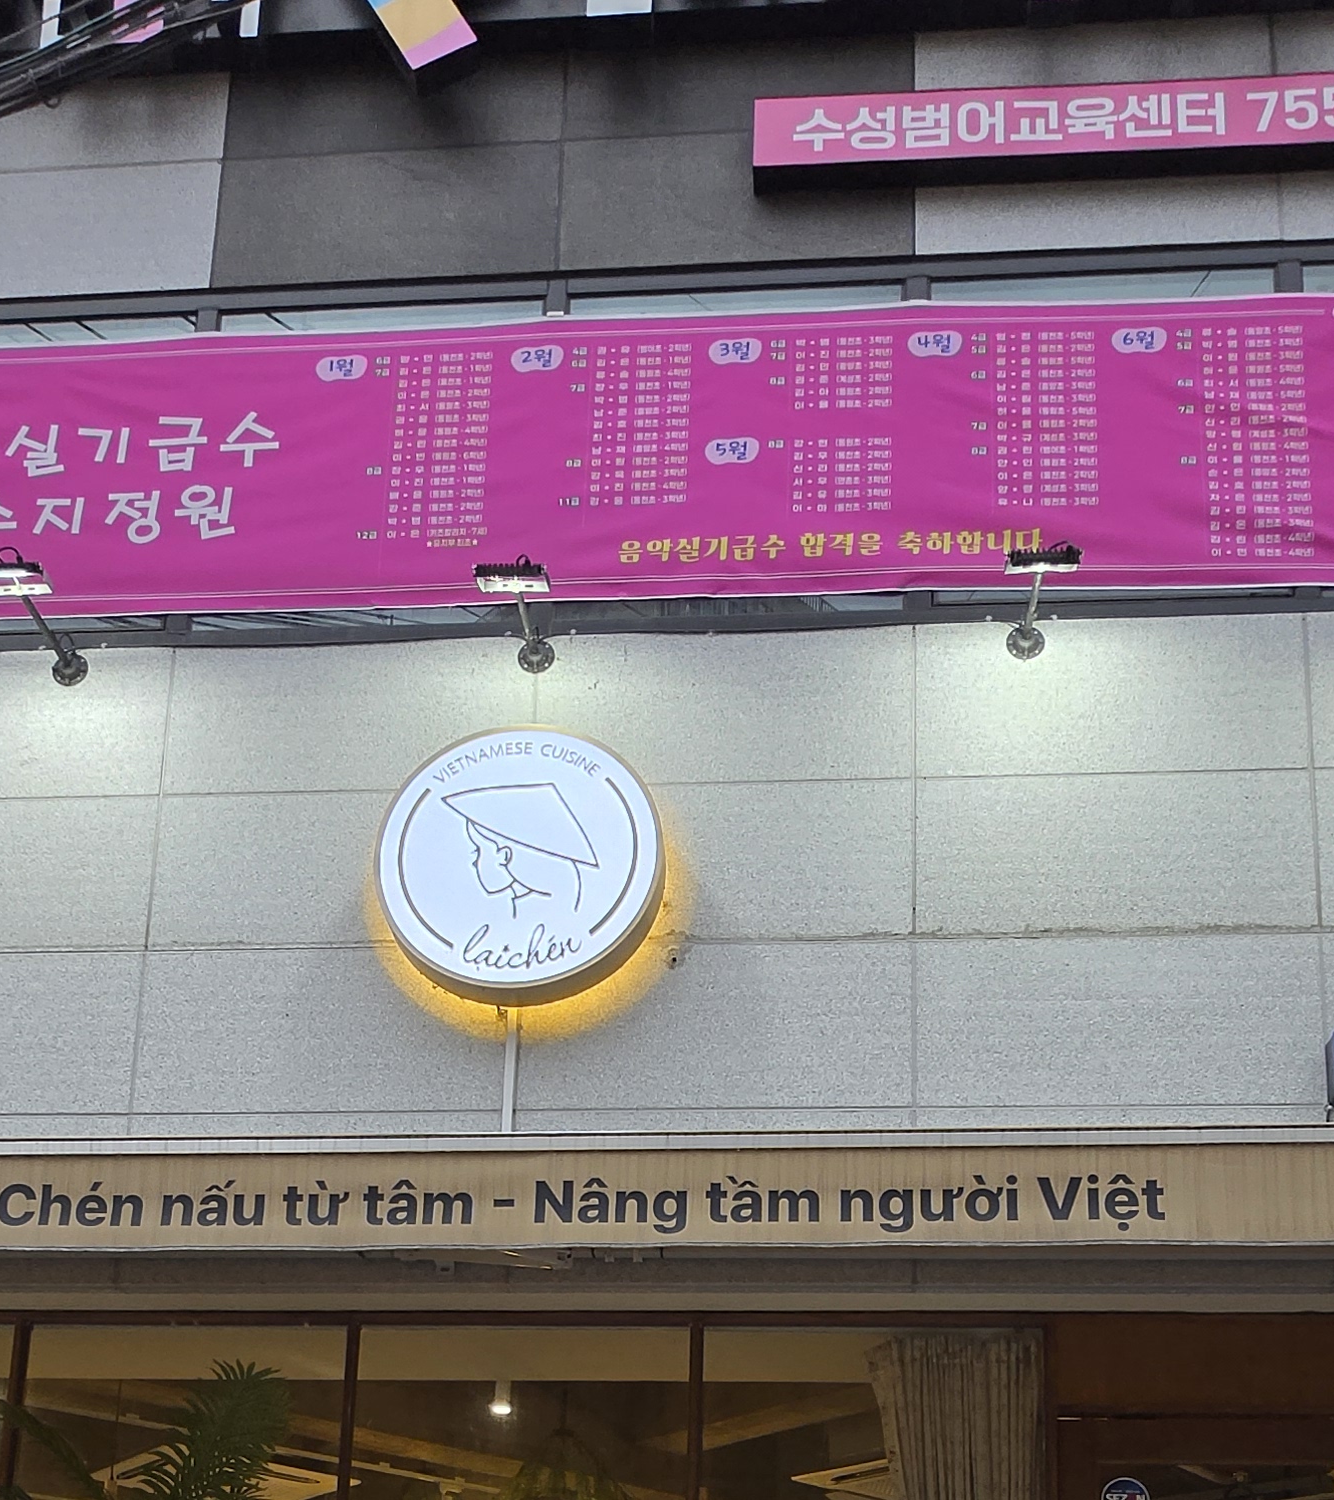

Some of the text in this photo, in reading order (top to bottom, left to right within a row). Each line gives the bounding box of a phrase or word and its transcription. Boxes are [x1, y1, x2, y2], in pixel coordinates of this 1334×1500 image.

[792, 92, 1226, 151] 수성범어교육센터
[1123, 331, 1154, 349] 6월
[521, 349, 552, 367] 2월
[720, 342, 750, 360] 3월
[329, 359, 353, 377] 1월
[716, 441, 747, 460] 5월
[618, 528, 1043, 563] 음악실기급수 합격을 축하합니다
[432, 742, 602, 784] VIETNAMESE CUISINE
[159, 1179, 265, 1227] nấu
[282, 1180, 350, 1226] từ
[364, 1180, 473, 1226] tâm
[534, 1178, 688, 1233] Nâng
[705, 1175, 830, 1225] tầm
[848, 1175, 1019, 1233] người
[1036, 1175, 1165, 1232] Việt
